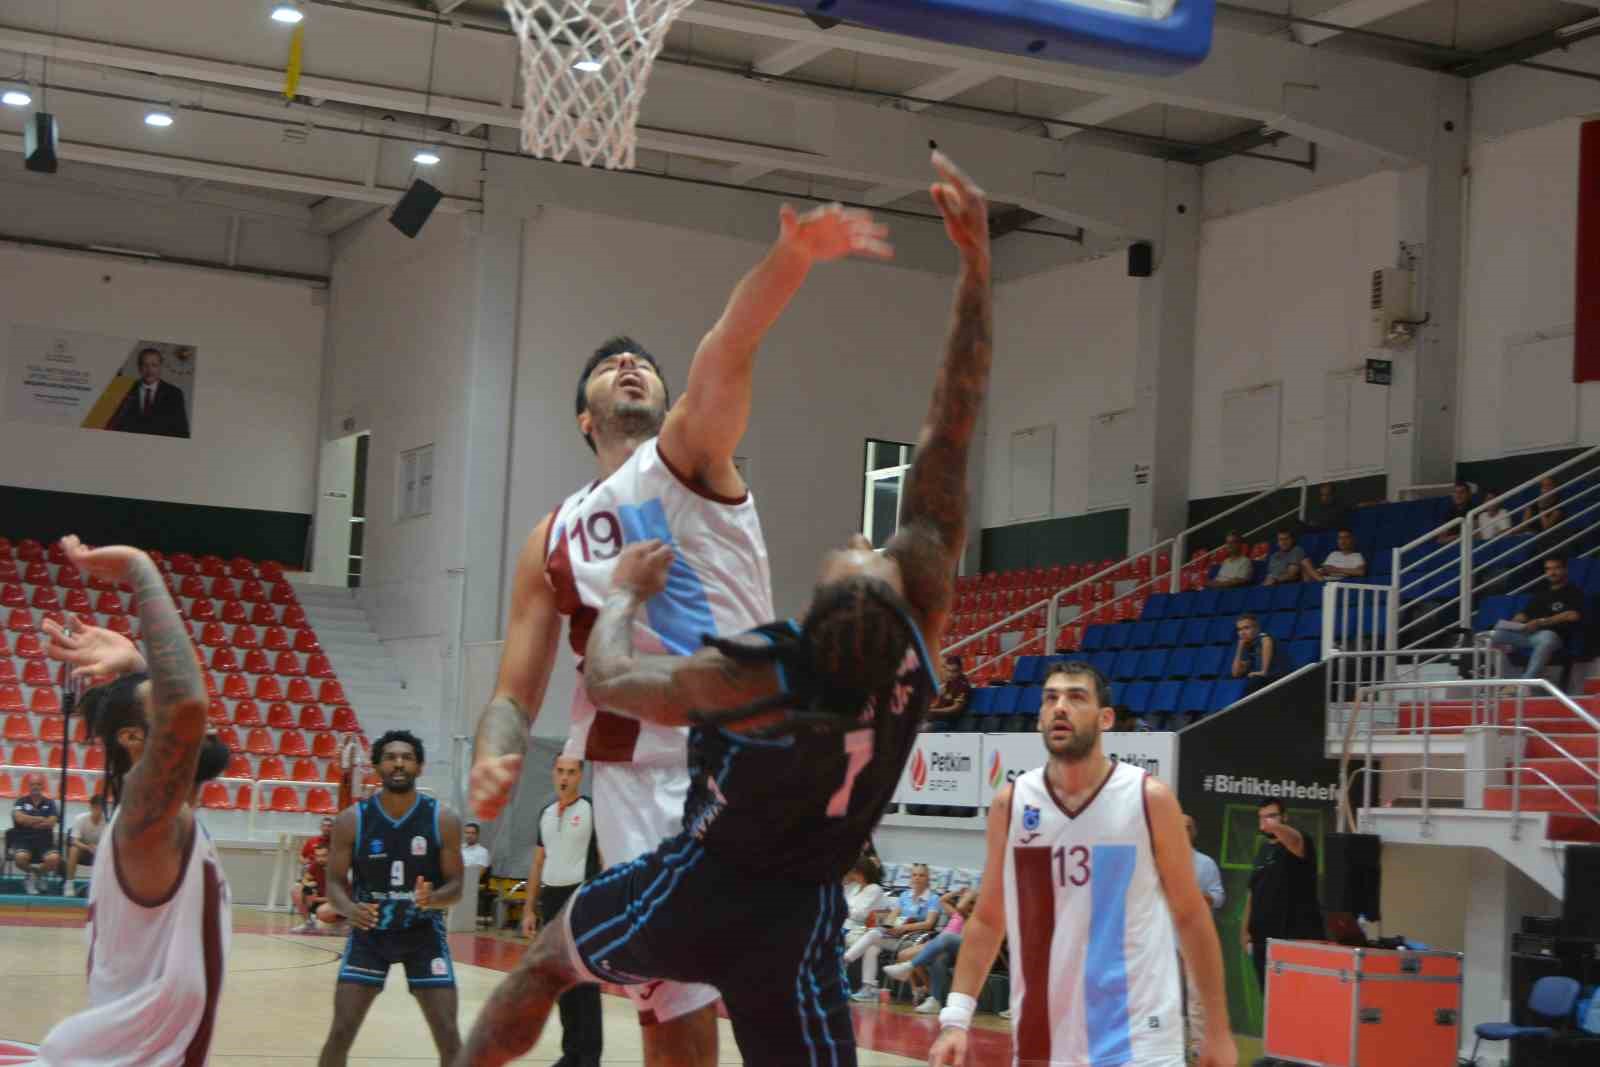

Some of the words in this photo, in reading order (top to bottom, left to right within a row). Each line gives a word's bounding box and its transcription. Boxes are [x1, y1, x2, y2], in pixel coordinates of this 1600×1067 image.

[570, 511, 623, 562] 19
[930, 752, 971, 772] Petkim
[1054, 845, 1091, 887] 13
